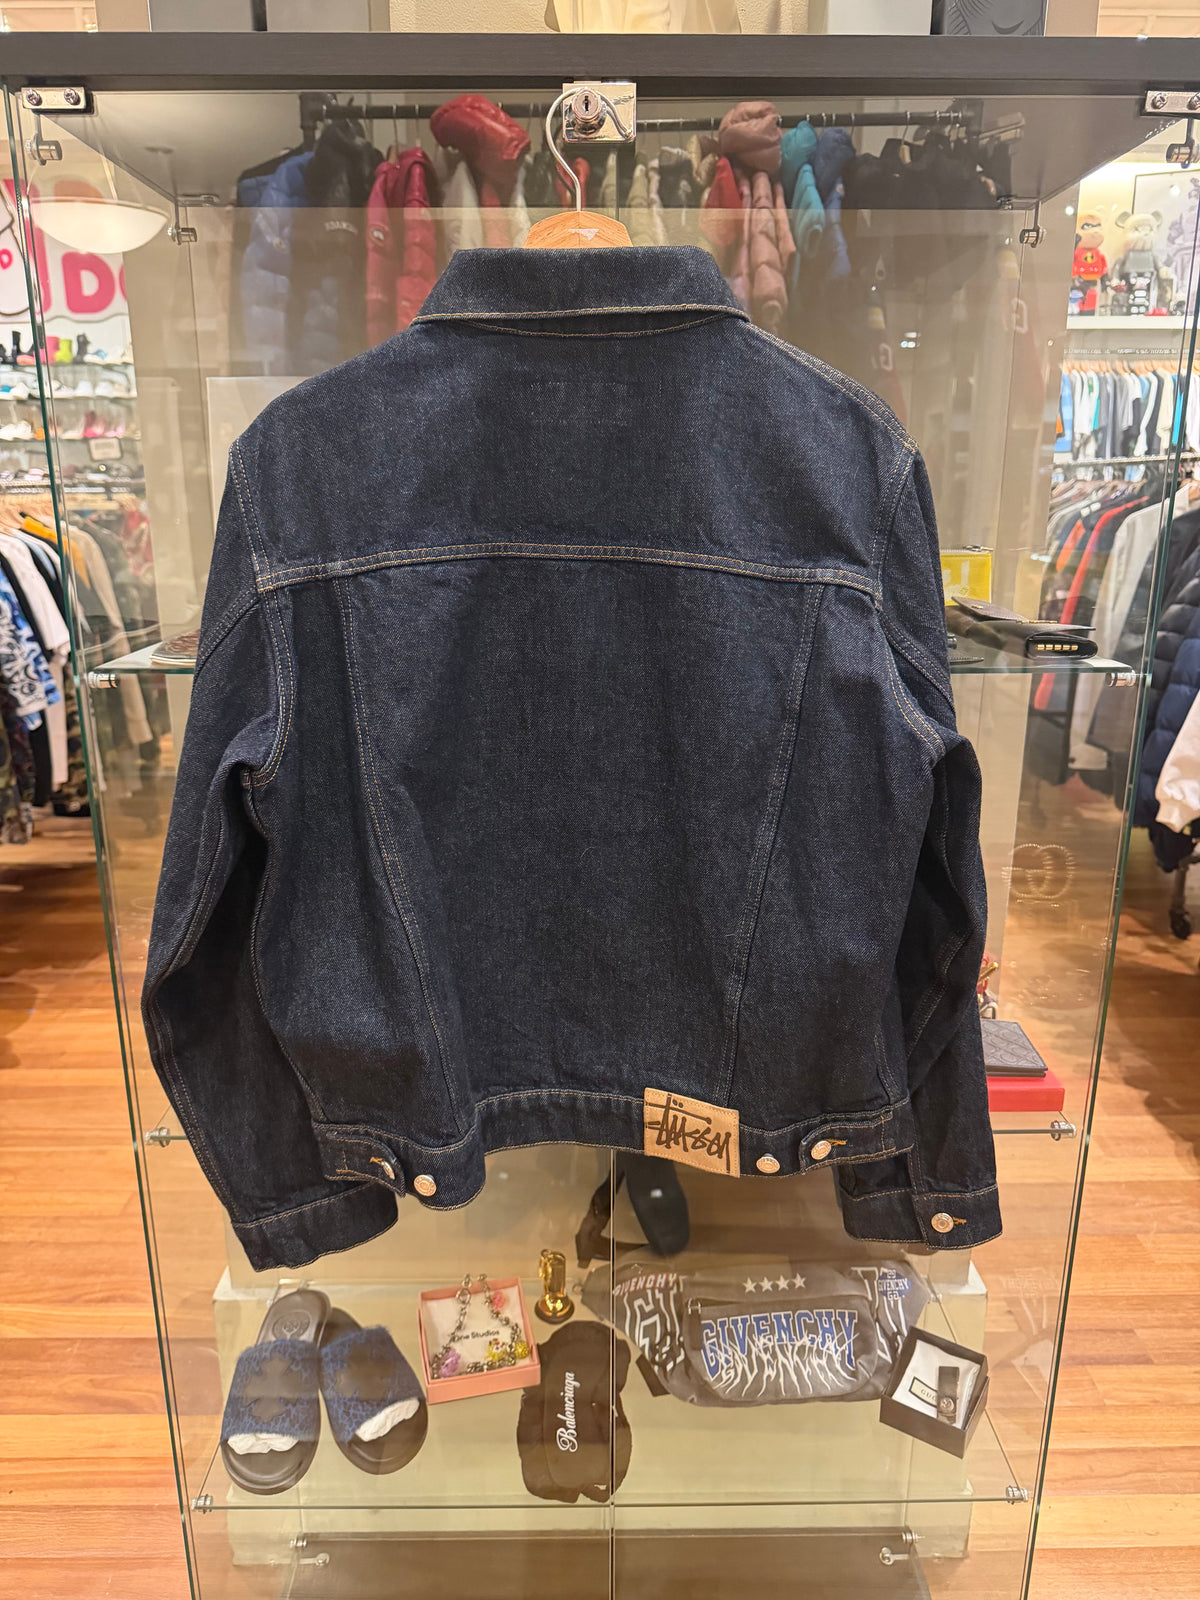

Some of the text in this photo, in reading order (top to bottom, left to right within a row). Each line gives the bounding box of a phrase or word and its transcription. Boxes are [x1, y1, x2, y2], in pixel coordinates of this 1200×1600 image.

[471, 1329, 500, 1339] Studios
[701, 1309, 859, 1381] GIVENCHY
[556, 1371, 581, 1453] Balenciaga
